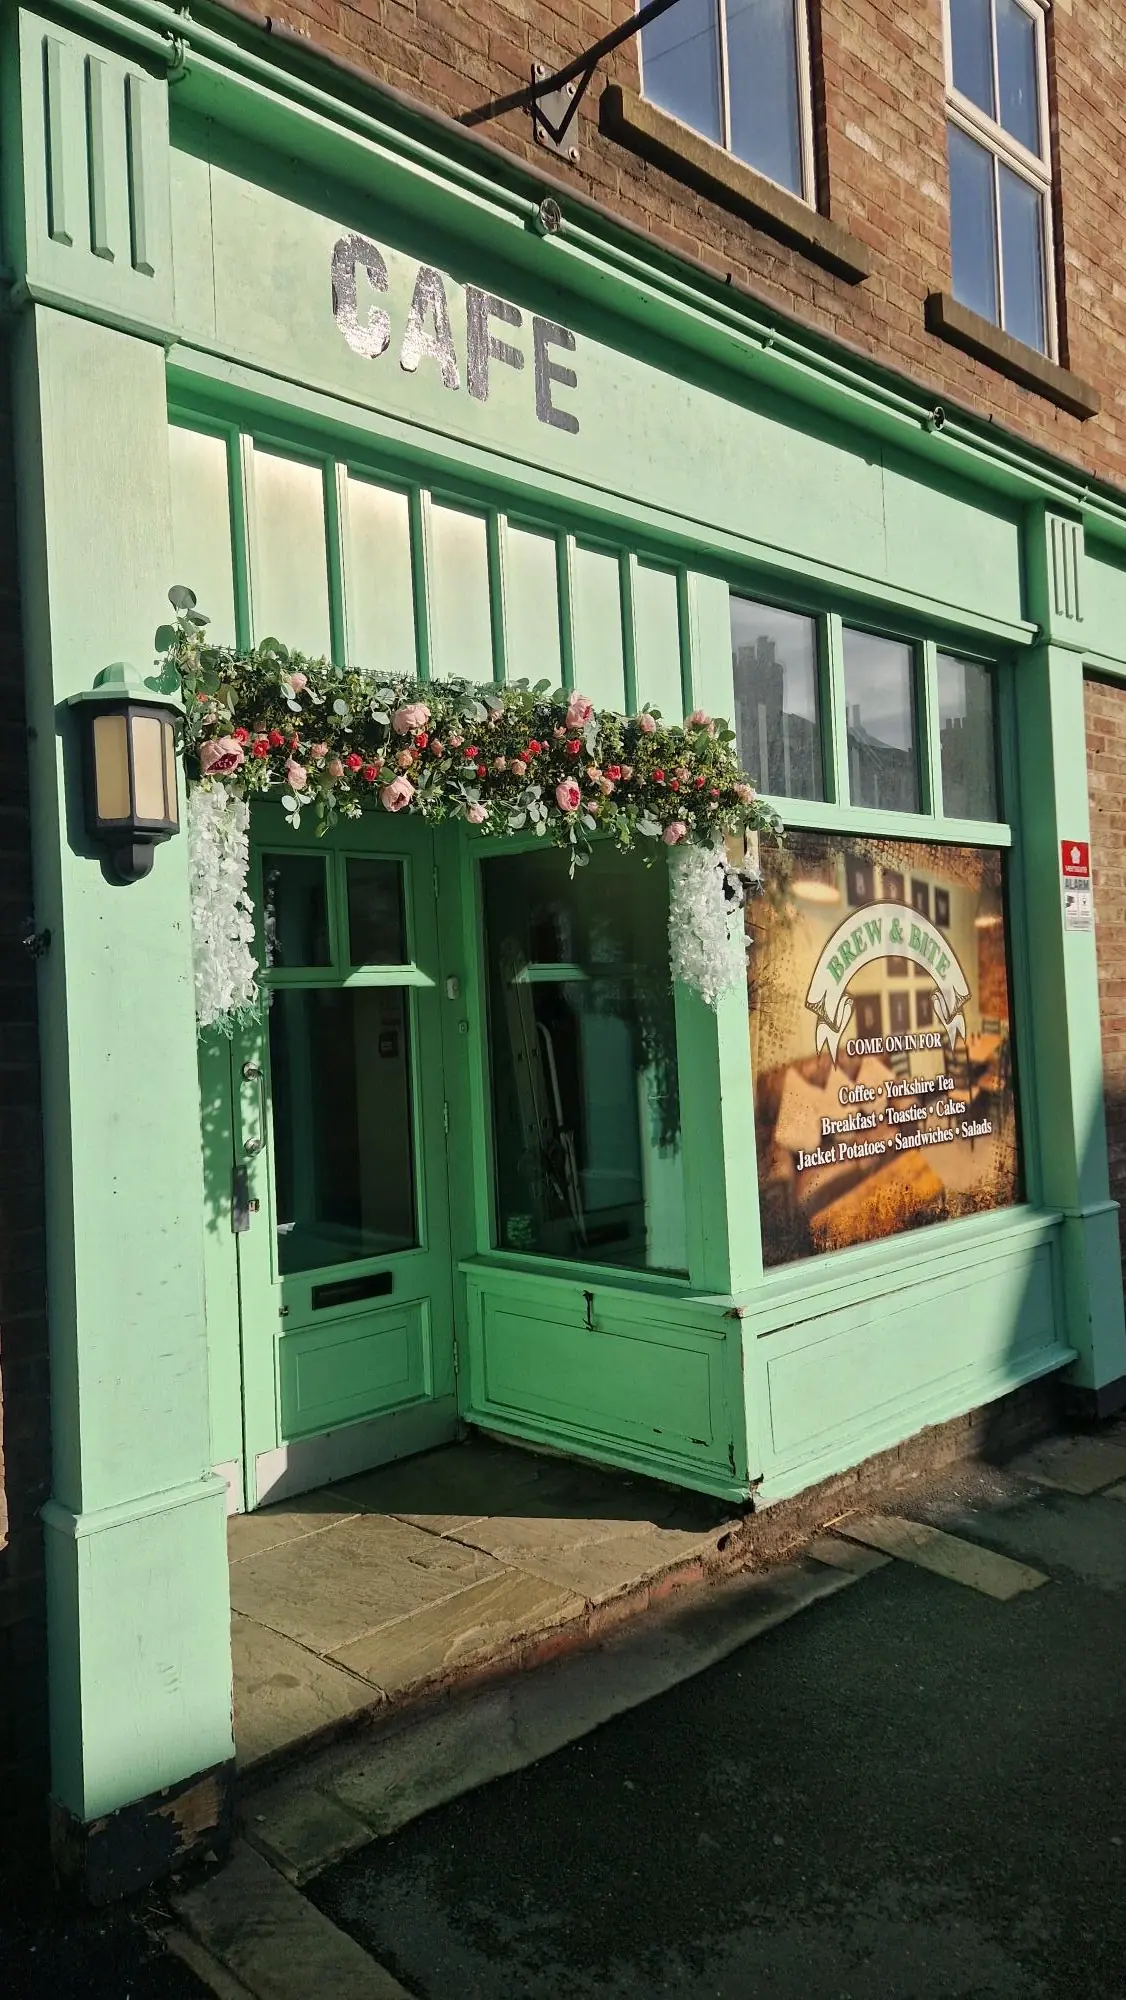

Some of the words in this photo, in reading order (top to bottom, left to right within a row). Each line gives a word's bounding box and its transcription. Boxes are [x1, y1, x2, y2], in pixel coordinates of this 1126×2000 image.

[331, 233, 580, 435] CAFE
[1065, 878, 1089, 890] ALARM
[826, 917, 882, 986] BREW
[889, 917, 903, 945] &
[908, 922, 951, 981] BITE
[846, 1037, 884, 1056] COME
[885, 1035, 903, 1052] ON
[904, 1033, 918, 1050] IN
[919, 1032, 942, 1049] FOR
[839, 1084, 876, 1104] Coffee
[884, 1077, 935, 1098] Yorkshire
[936, 1074, 955, 1091] Tea
[821, 1111, 877, 1136] Breakfast
[885, 1104, 927, 1125] Toasties
[936, 1099, 966, 1117] Cakes
[796, 1146, 837, 1171] Jacket
[838, 1140, 886, 1161] Potatoes
[895, 1126, 954, 1150] Sandwiches
[961, 1119, 992, 1138] Salads
